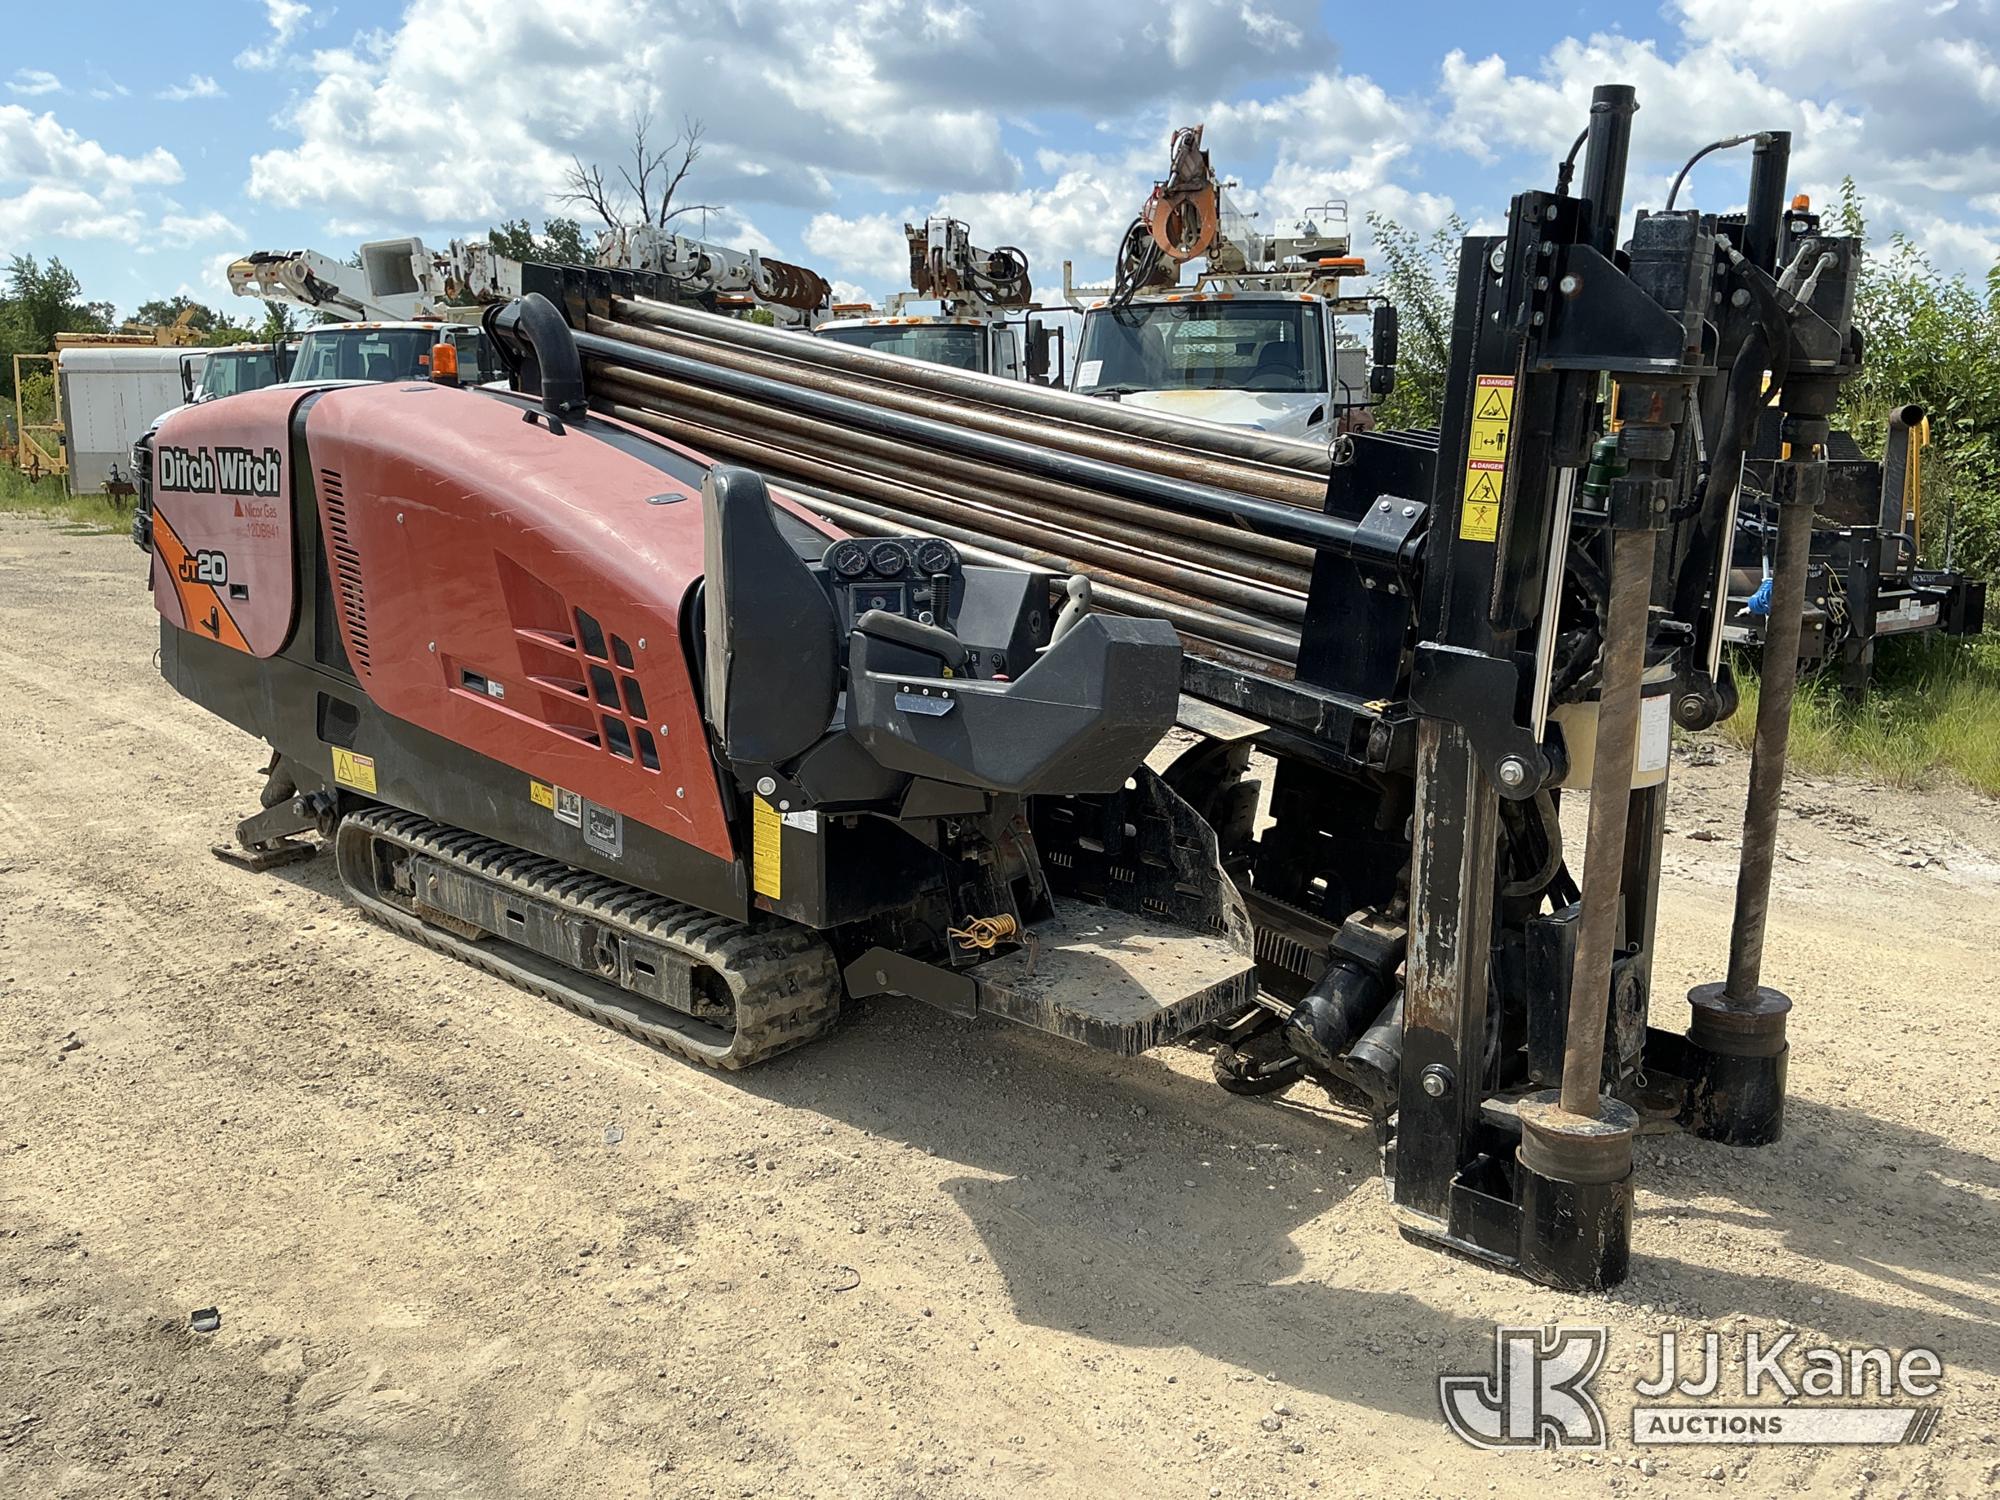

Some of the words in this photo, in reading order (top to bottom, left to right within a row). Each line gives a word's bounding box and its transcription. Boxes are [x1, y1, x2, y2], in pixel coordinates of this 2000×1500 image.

[1486, 378, 1514, 387] DANGER
[160, 449, 214, 491] Ditch
[217, 450, 279, 493] Witch
[1477, 462, 1504, 470] DANGER
[180, 551, 227, 584] JT20
